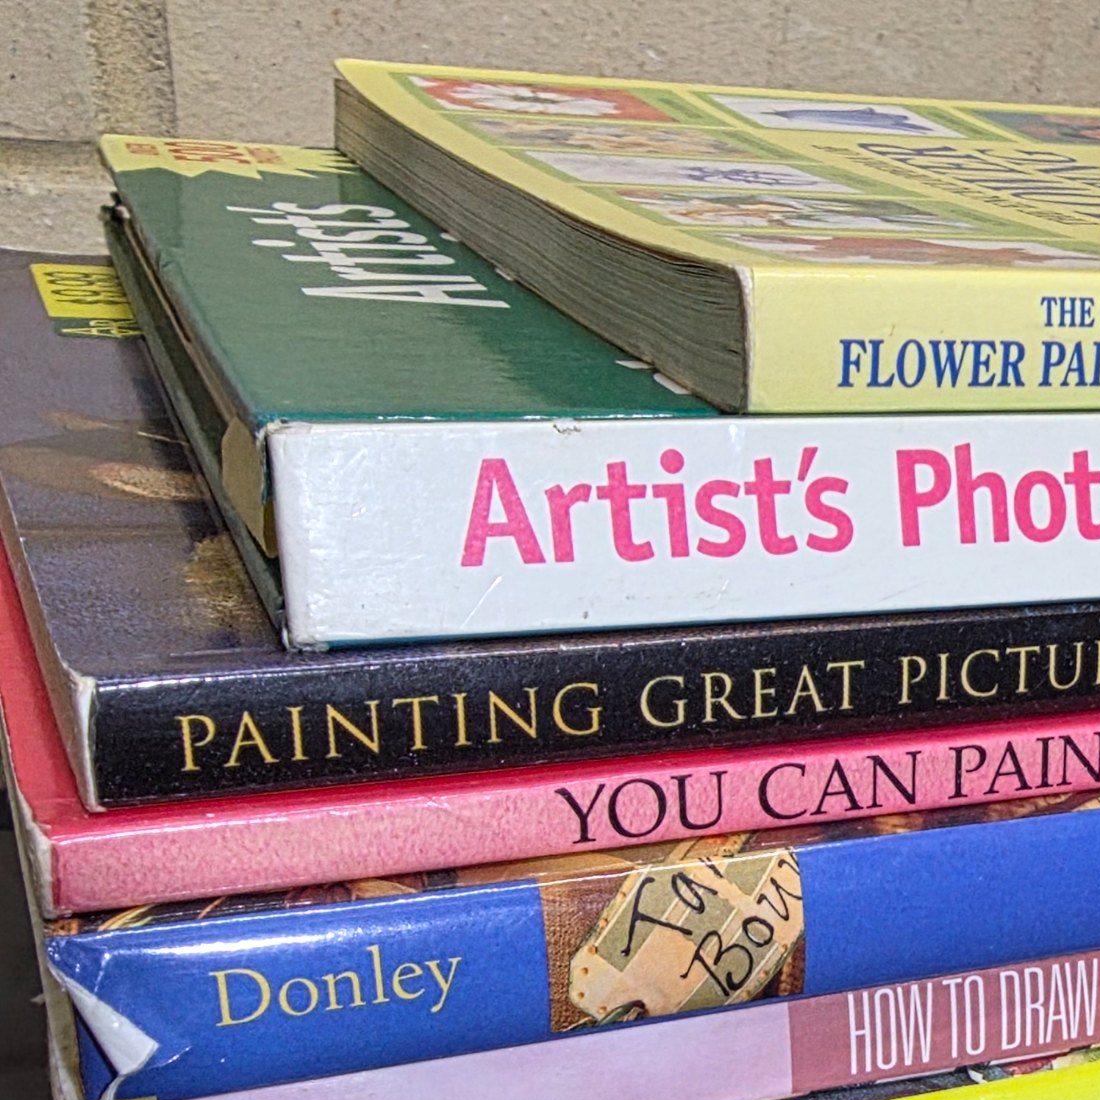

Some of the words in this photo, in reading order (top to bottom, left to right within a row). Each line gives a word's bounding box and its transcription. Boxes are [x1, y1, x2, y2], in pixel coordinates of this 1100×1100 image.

[1040, 297, 1096, 330] THE
[837, 339, 1026, 390] FLOWER
[460, 446, 855, 567] Artist's
[177, 682, 602, 773] PAINTING
[640, 660, 865, 729] GREAT
[555, 771, 727, 845] YOU
[758, 751, 921, 821] CAN
[208, 945, 463, 1028] Donley
[848, 982, 935, 1076] HOW
[942, 974, 989, 1060] TO
